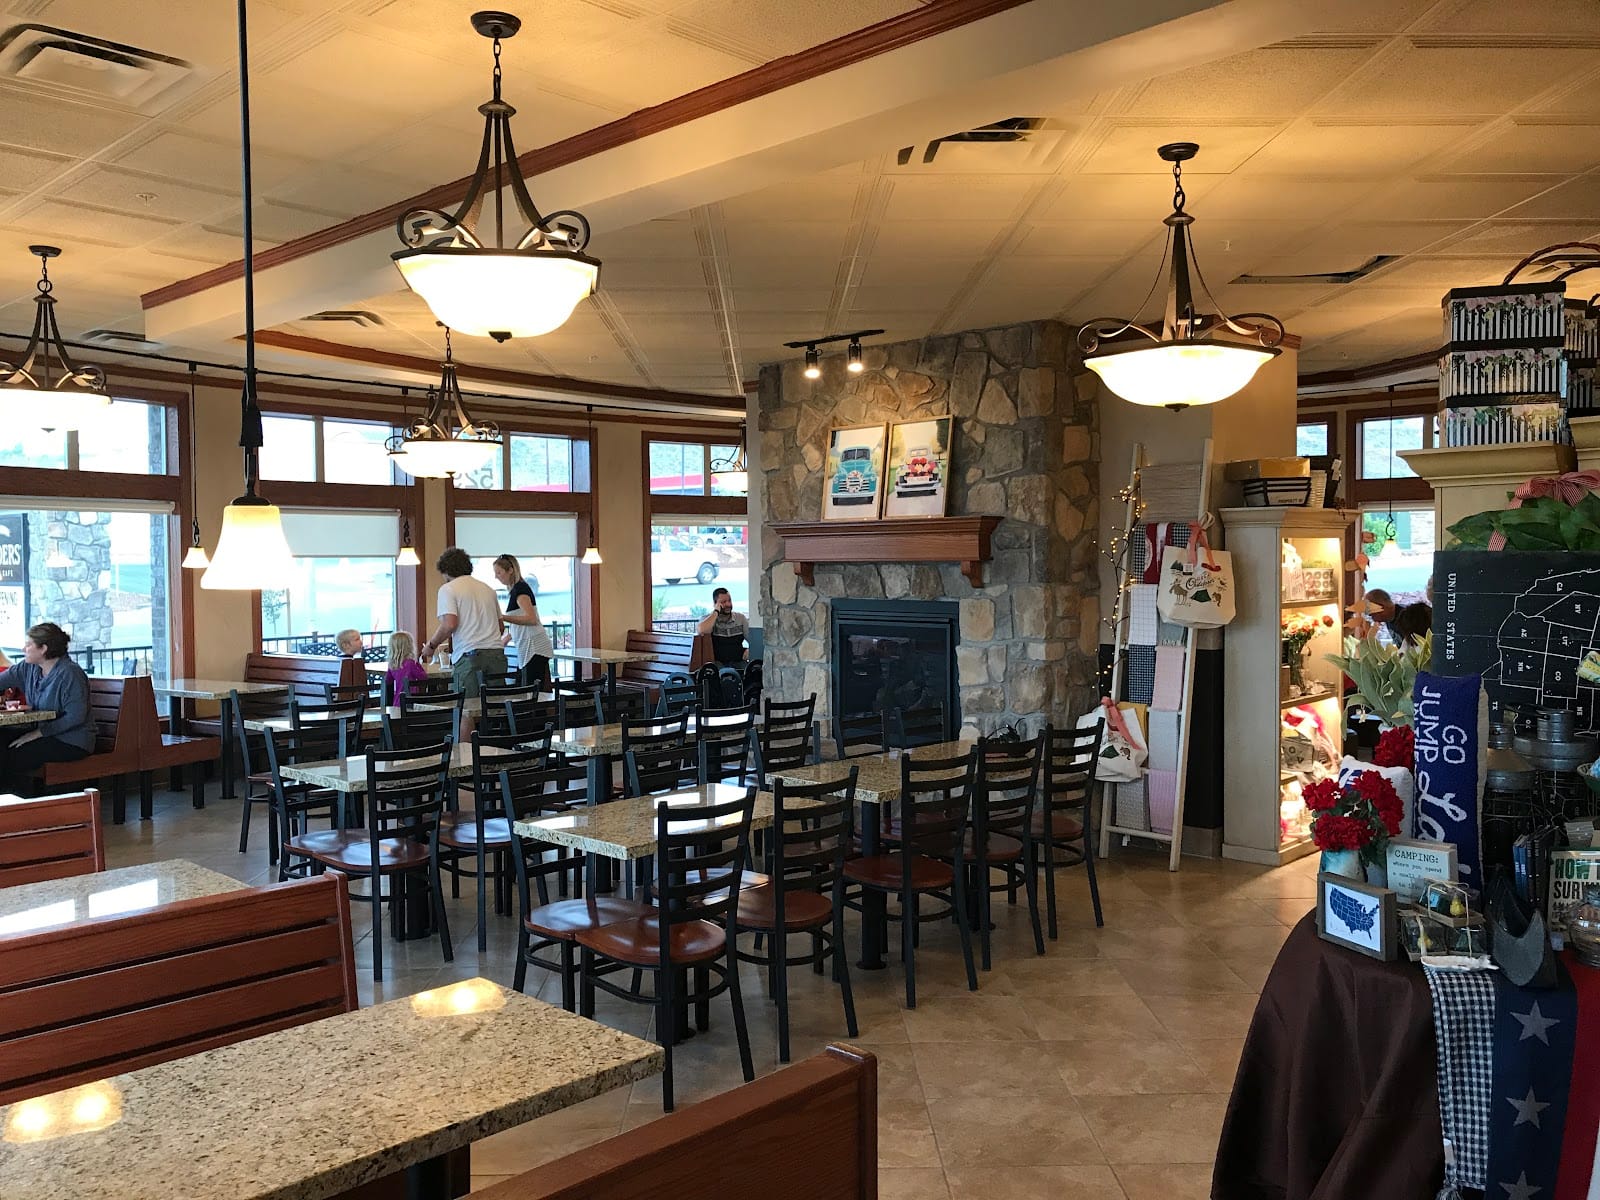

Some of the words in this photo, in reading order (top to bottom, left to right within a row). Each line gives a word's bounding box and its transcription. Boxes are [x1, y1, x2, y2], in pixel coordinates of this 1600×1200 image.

[0, 543, 20, 565] ERS
[1447, 572, 1456, 613] UNITED
[1556, 581, 1563, 592] CA
[1446, 622, 1455, 660] STATES
[1561, 635, 1569, 646] UT
[1554, 670, 1562, 681] CO
[1417, 685, 1442, 764] JUMP
[1442, 724, 1468, 764] GO
[1418, 770, 1471, 875] La
[1394, 849, 1439, 864] CAMPING:
[1555, 859, 1591, 879] HOW
